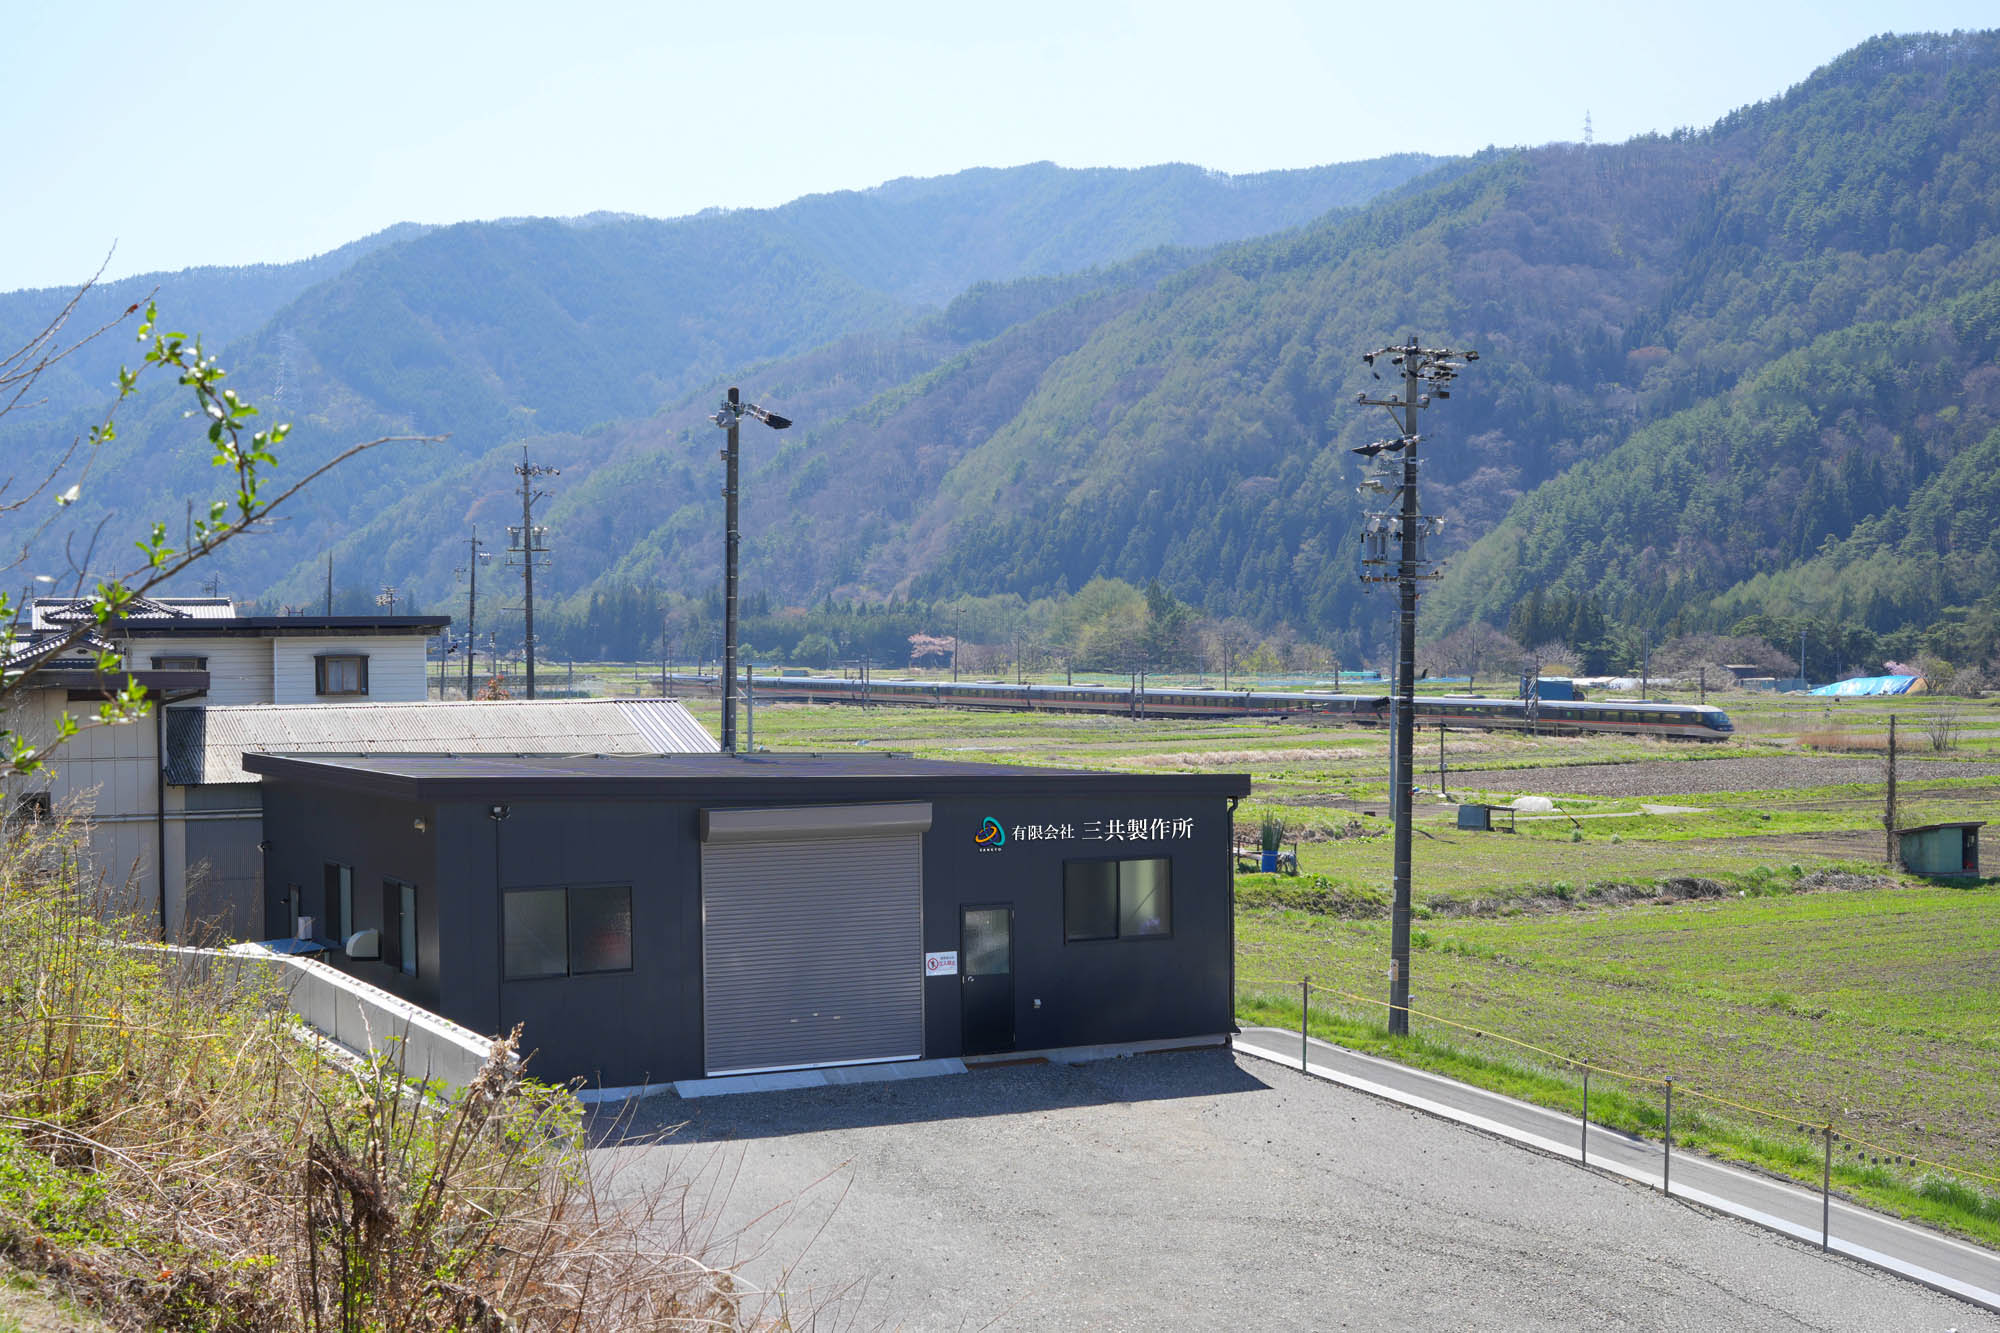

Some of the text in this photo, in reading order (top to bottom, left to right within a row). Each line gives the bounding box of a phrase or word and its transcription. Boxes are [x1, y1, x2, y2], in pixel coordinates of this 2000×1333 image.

[1011, 817, 1195, 842] 有限会社 三共製作所
